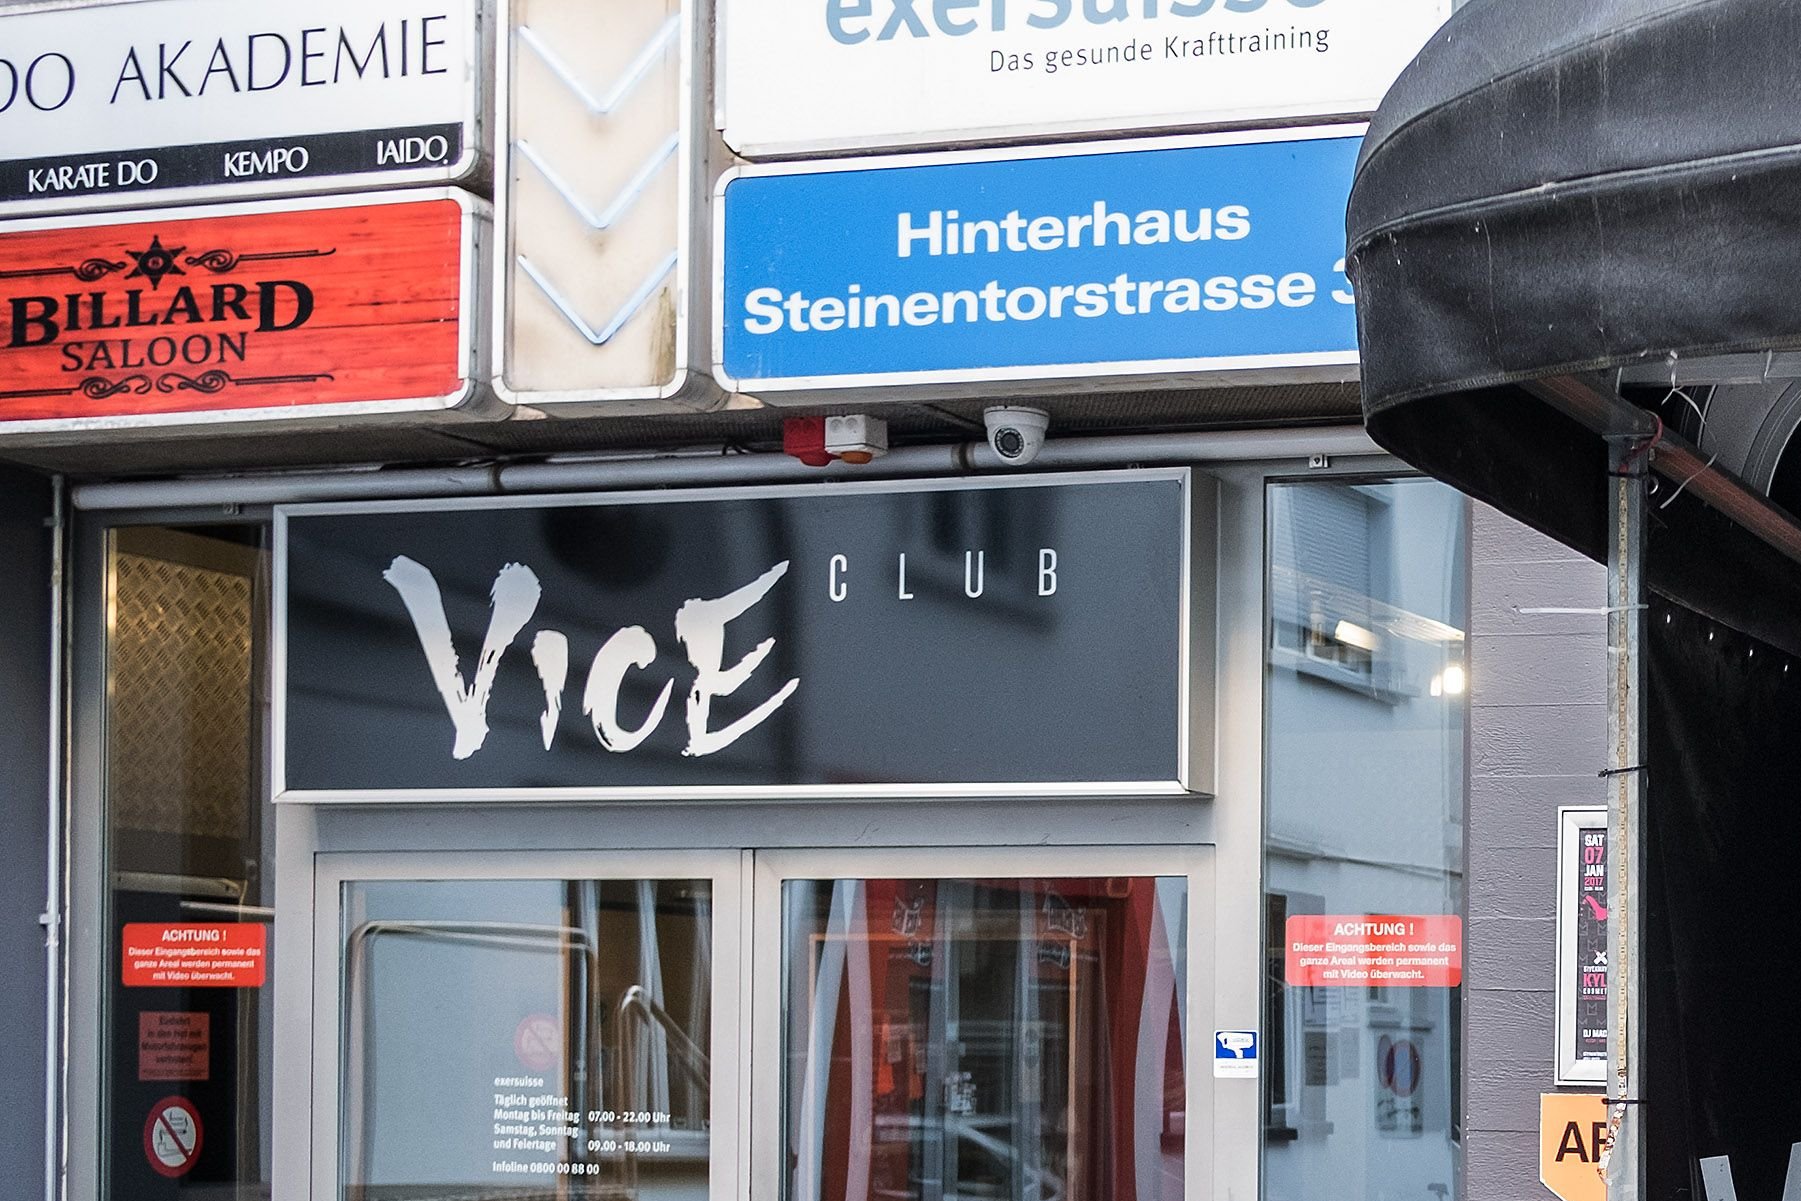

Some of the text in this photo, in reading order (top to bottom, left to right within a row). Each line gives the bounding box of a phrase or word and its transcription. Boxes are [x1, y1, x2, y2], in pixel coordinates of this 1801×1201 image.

[990, 25, 1332, 74] Das gesunde Krafttraining
[110, 15, 449, 105] AKADEMIE
[28, 163, 110, 193] KARATE
[117, 159, 158, 187] DO
[223, 145, 309, 178] KEMPO
[897, 200, 1251, 258] Hinterhaus
[743, 269, 1316, 335] Steinentorstrasse
[10, 278, 315, 350] BILLARD
[60, 331, 249, 374] SALOON
[828, 548, 1058, 603] CLUB
[1584, 834, 1605, 847] SAT
[1584, 847, 1604, 864] 07
[1584, 864, 1604, 877] JAN
[1584, 877, 1604, 886] 2017
[162, 929, 220, 942] ACHTUNG
[1333, 923, 1406, 936] ACHTUNG
[128, 947, 261, 957] Dieser Eingangsbereich sowie das
[1292, 943, 1457, 954] Dieser Eingangsbereich sowie das
[181, 959, 211, 969] werden
[1299, 956, 1449, 967] ganze Areal werden permanent
[166, 971, 190, 980] Video
[1323, 969, 1425, 979] mit Video überwacht.
[1582, 1028, 1592, 1038] DJ
[494, 1075, 544, 1088] exersuisse
[494, 1094, 568, 1108] Täglich geöffnet
[494, 1109, 529, 1122] Montag
[531, 1110, 546, 1121] bis
[547, 1110, 580, 1124] Freitag
[588, 1111, 615, 1122] 07.00
[622, 1112, 651, 1123] 22.00
[652, 1112, 671, 1123] Uhr
[494, 1124, 579, 1138] Samstag, Sonntag
[493, 1138, 511, 1149] und
[513, 1138, 556, 1152] Feiertage
[588, 1140, 616, 1152] 09.00
[624, 1141, 651, 1152] 18.00
[652, 1141, 671, 1152] Uhr
[492, 1161, 600, 1175] Infoline 0800 00 88 00
